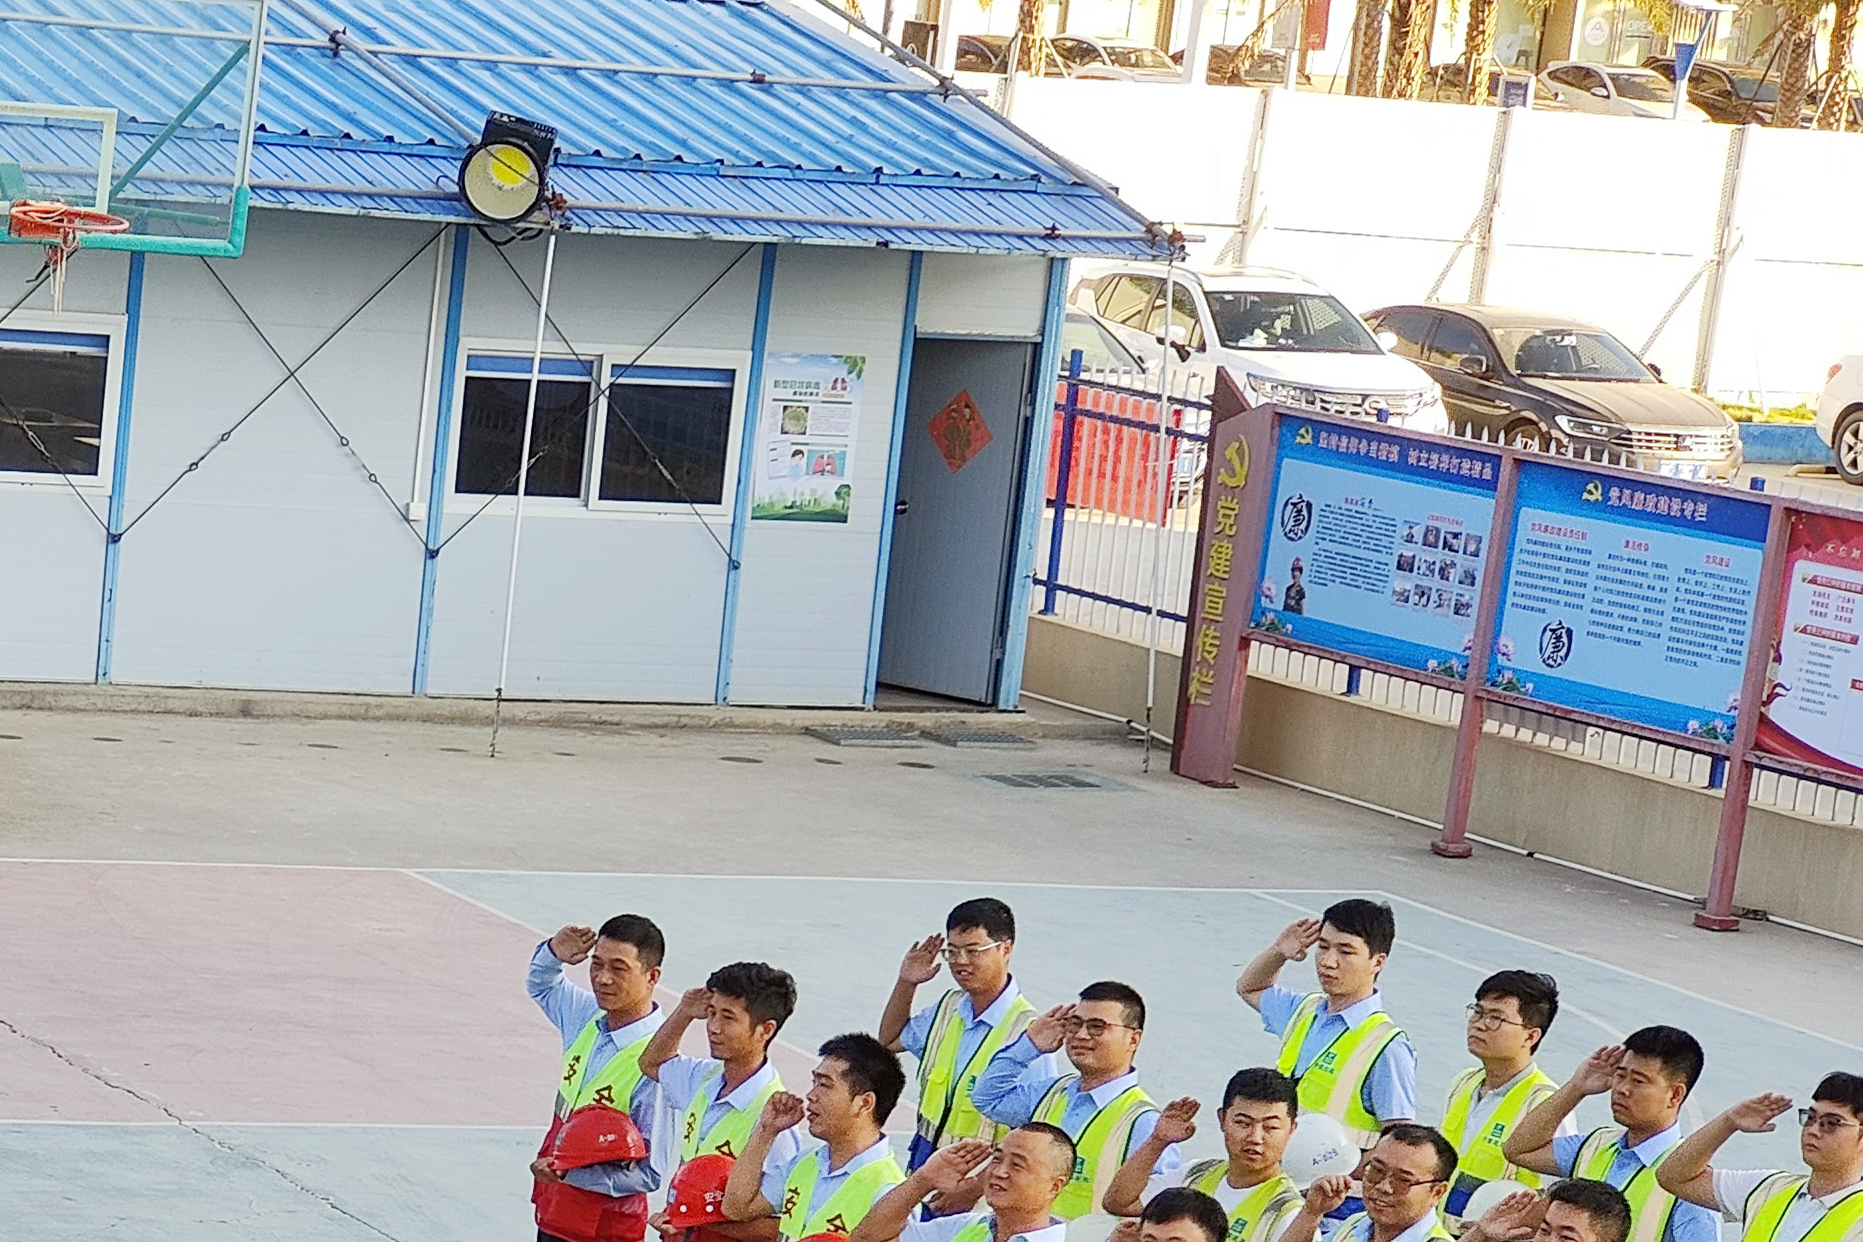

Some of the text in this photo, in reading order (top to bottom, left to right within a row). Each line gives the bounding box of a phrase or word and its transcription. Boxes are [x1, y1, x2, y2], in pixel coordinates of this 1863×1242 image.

[1626, 20, 1648, 31] OPE
[1188, 495, 1240, 707] 党建宣传栏
